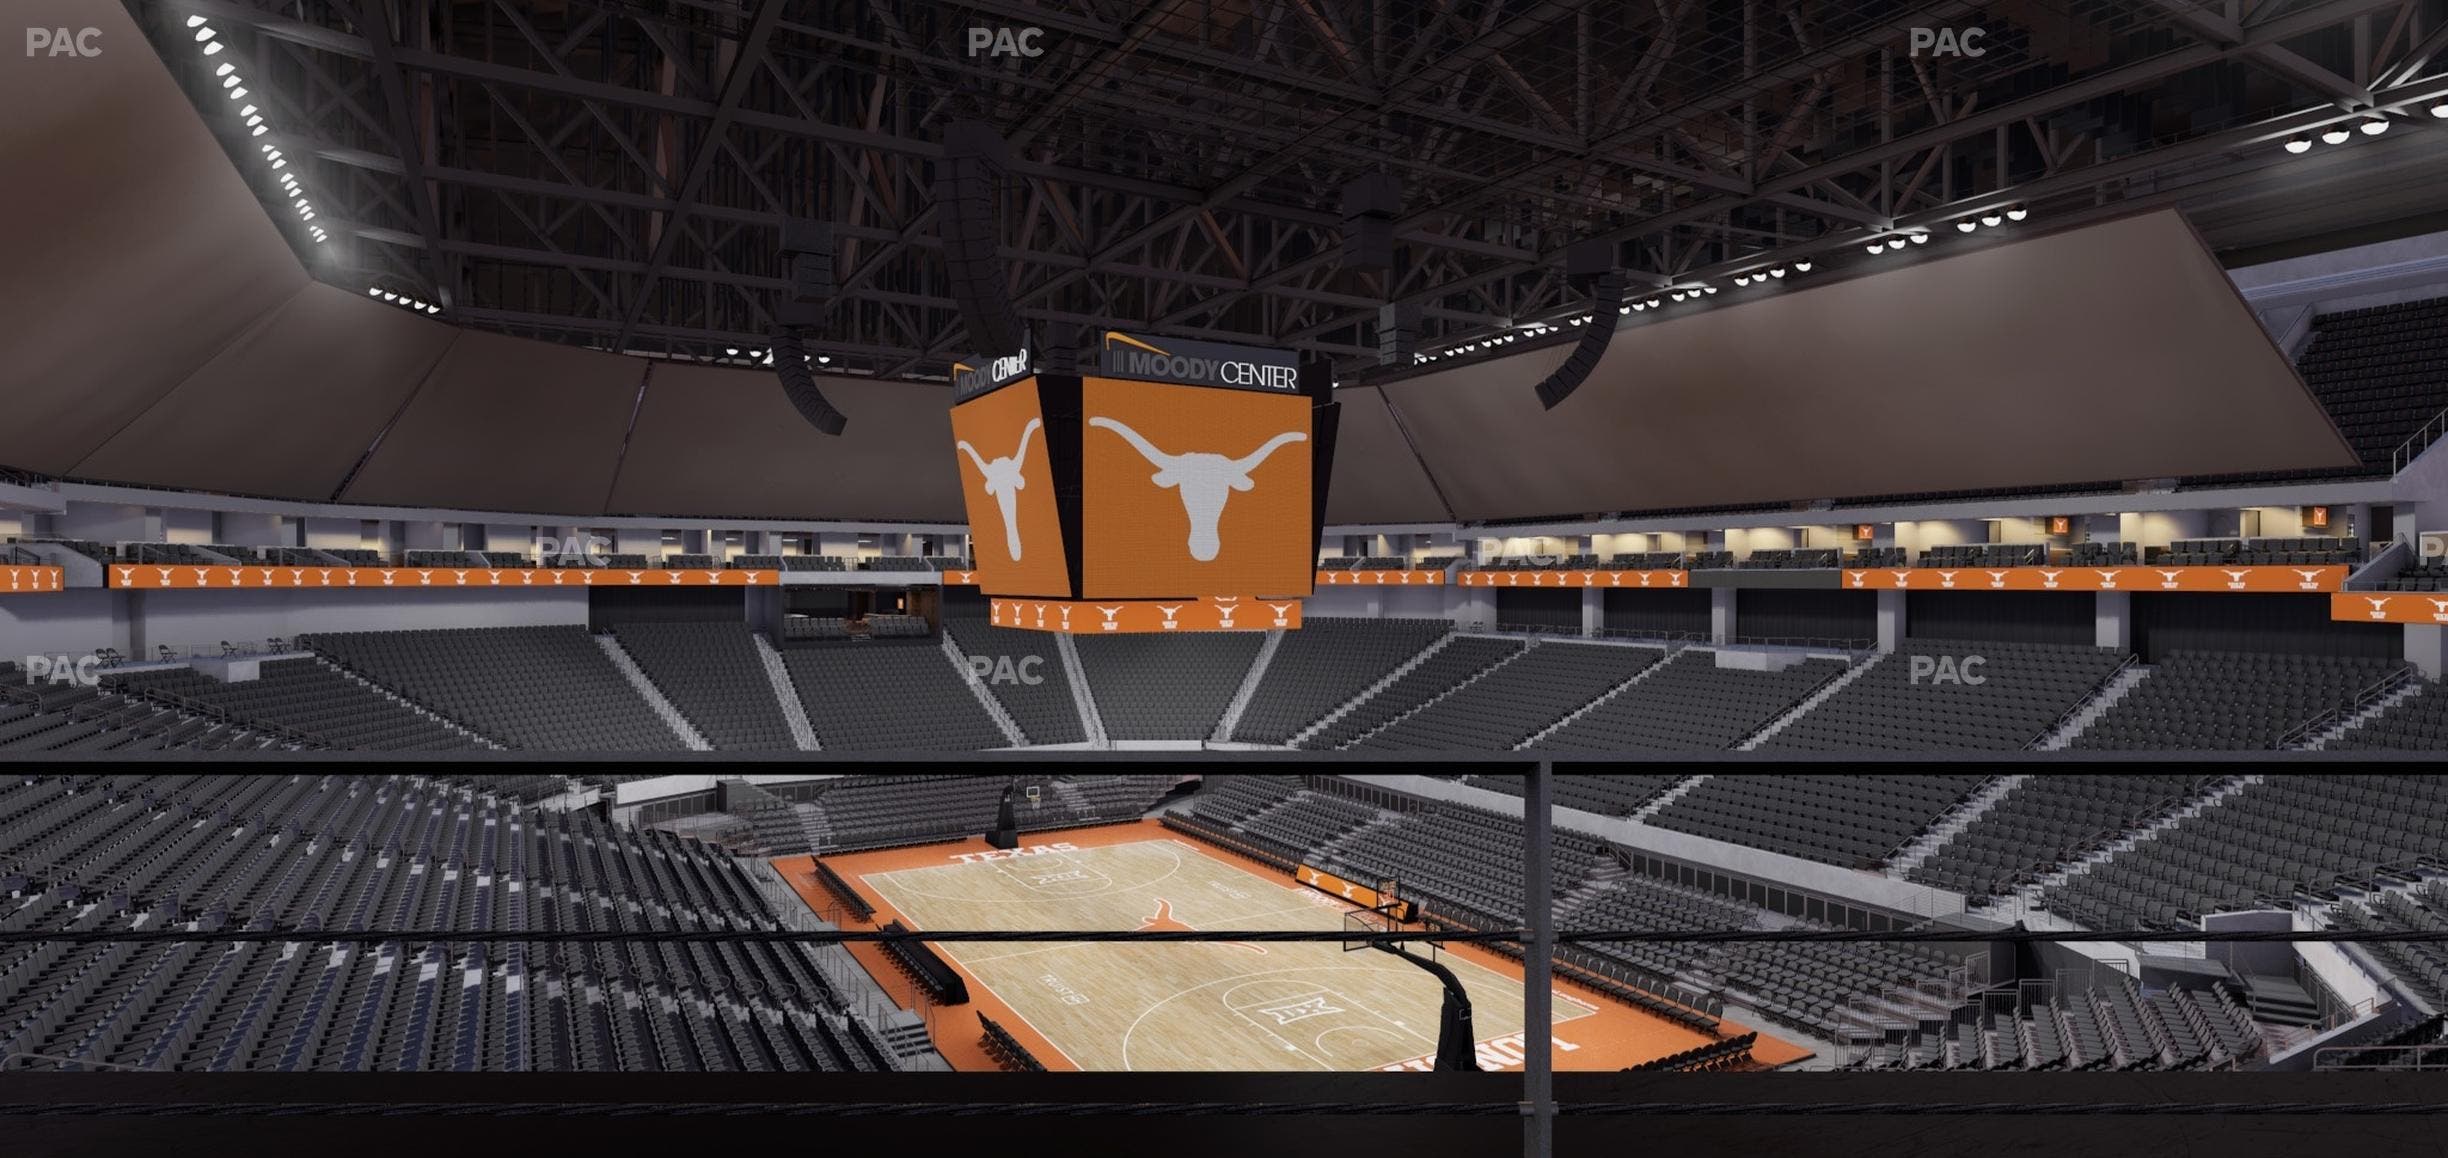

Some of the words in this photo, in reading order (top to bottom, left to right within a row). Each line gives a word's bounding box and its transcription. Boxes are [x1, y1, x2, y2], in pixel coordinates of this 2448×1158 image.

[992, 348, 1027, 382] CENTER
[1129, 351, 1220, 381] MOODY
[1220, 361, 1297, 389] CENTER
[949, 842, 1080, 865] TEXAS
